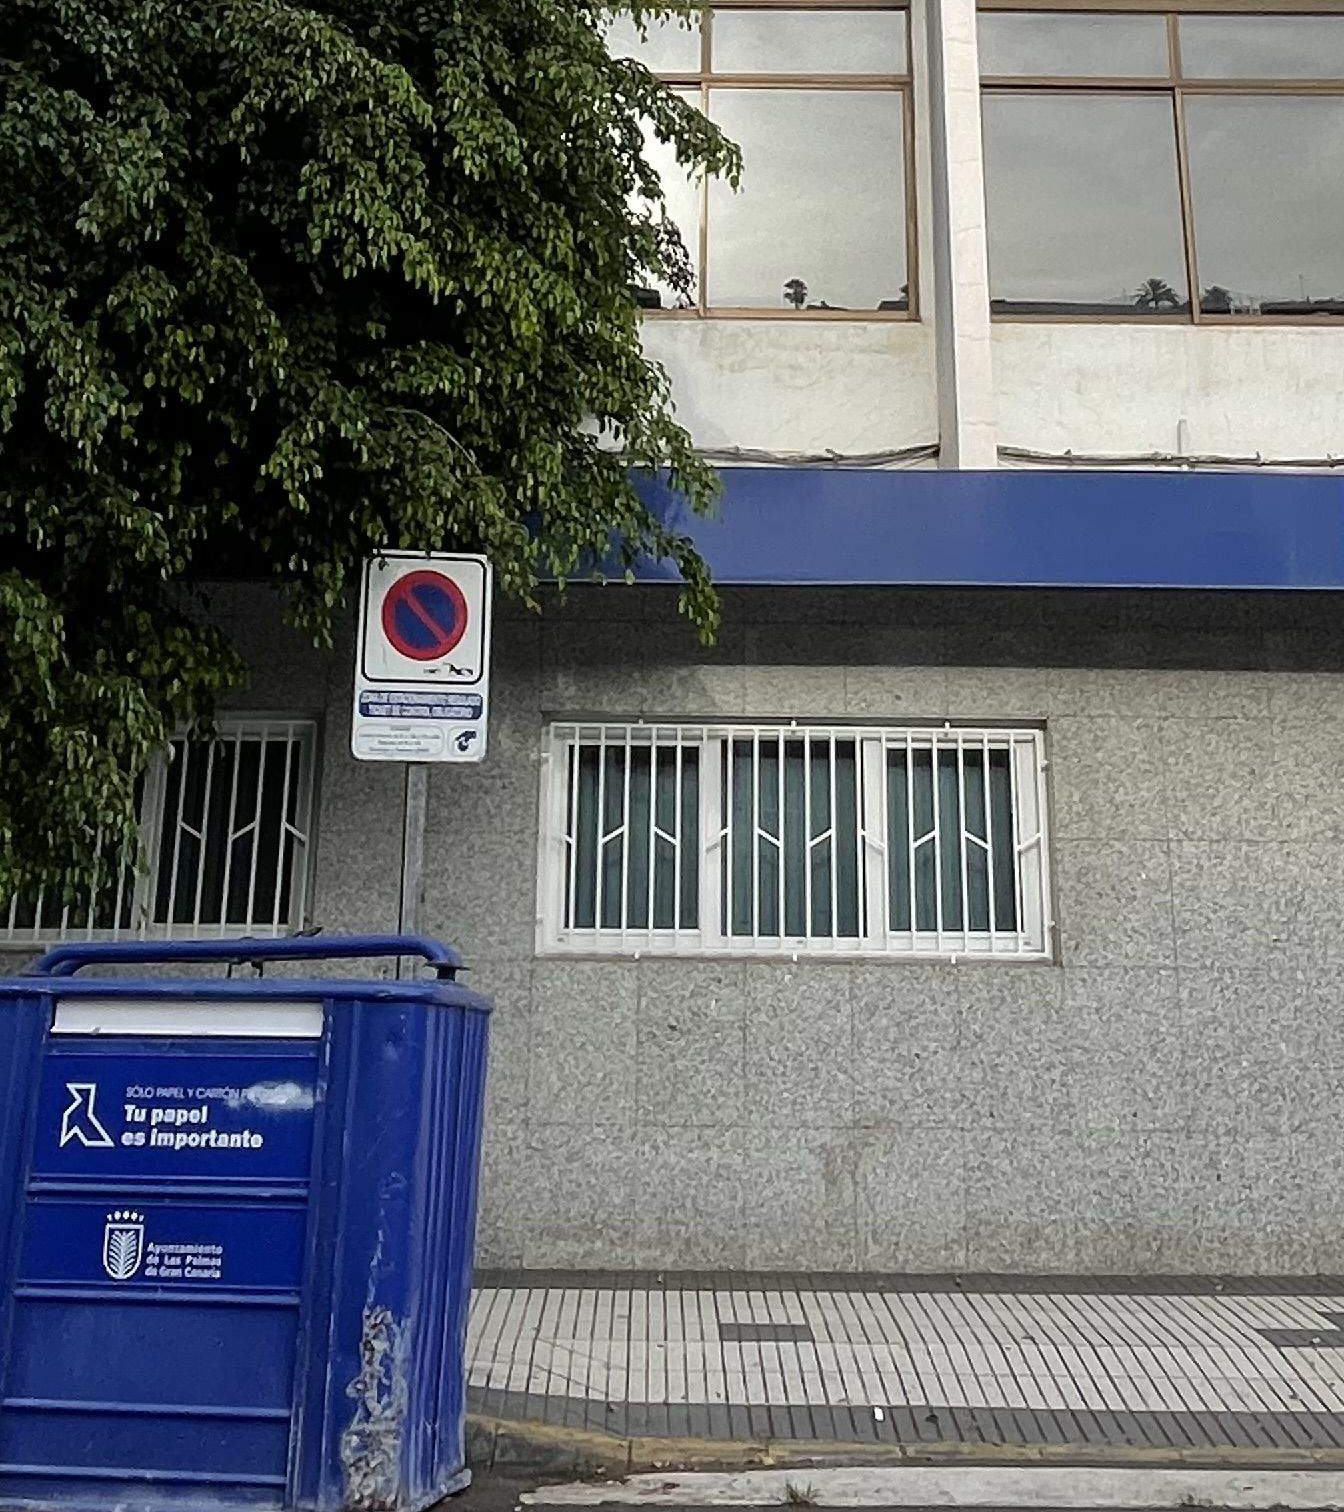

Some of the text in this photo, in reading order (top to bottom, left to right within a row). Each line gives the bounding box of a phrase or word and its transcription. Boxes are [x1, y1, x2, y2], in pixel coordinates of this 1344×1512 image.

[124, 1104, 208, 1126] Tu papel
[120, 1128, 264, 1150] es importante
